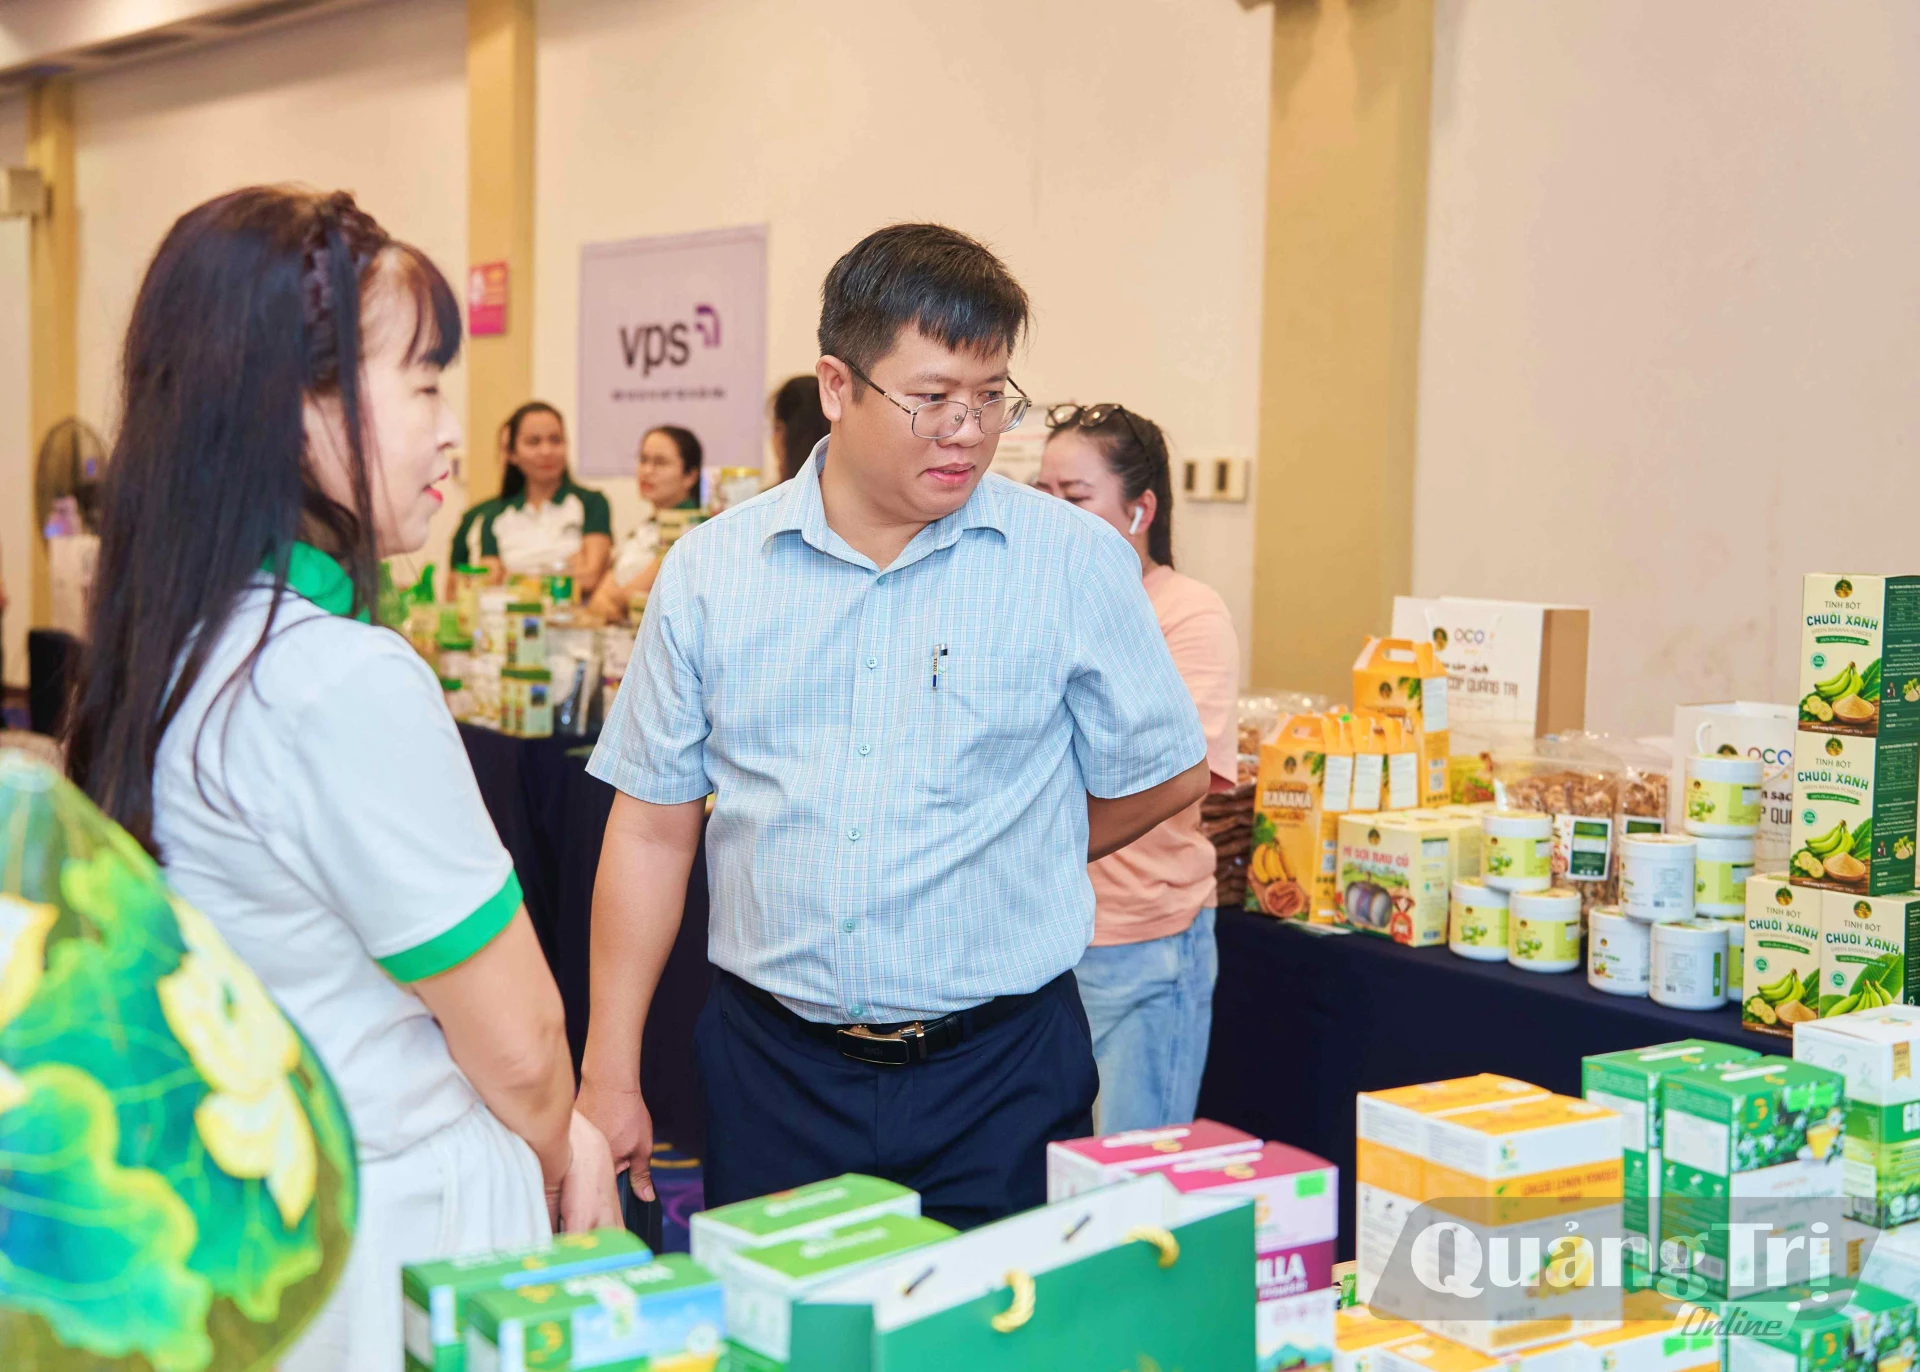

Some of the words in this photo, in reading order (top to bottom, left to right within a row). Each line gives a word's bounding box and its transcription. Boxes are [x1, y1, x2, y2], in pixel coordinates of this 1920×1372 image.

[619, 322, 690, 378] vps
[1824, 600, 1843, 609] TINH
[1845, 614, 1879, 631] XANH
[1815, 758, 1833, 767] TINH
[1836, 773, 1869, 790] XANH
[1766, 907, 1784, 916] TINH
[1786, 922, 1819, 940] XANH
[1843, 919, 1863, 930] TINH
[1865, 936, 1900, 955] XANH
